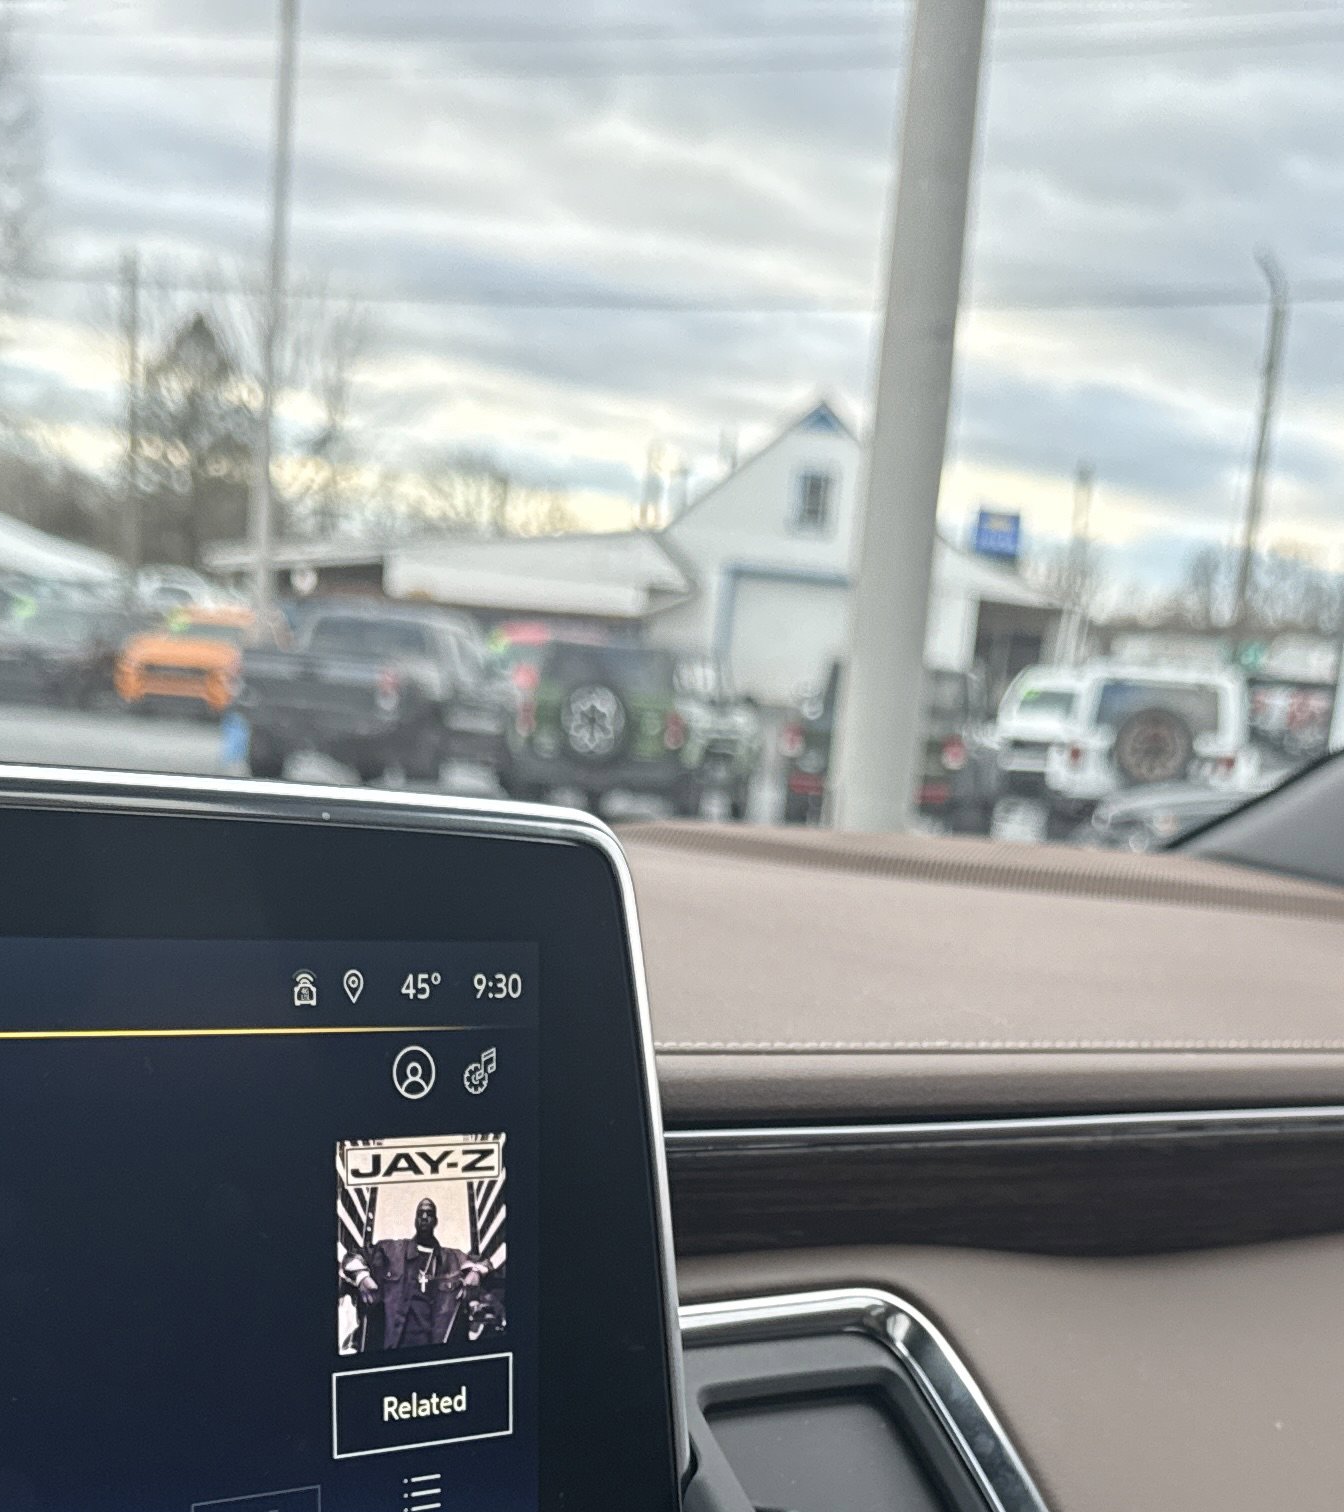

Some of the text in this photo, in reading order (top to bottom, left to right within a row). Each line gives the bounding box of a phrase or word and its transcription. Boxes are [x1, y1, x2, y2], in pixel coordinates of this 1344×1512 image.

[401, 972, 442, 1000] 45°
[473, 973, 523, 999] 9:30
[350, 1148, 496, 1179] JAY-Z
[382, 1385, 468, 1423] Related
